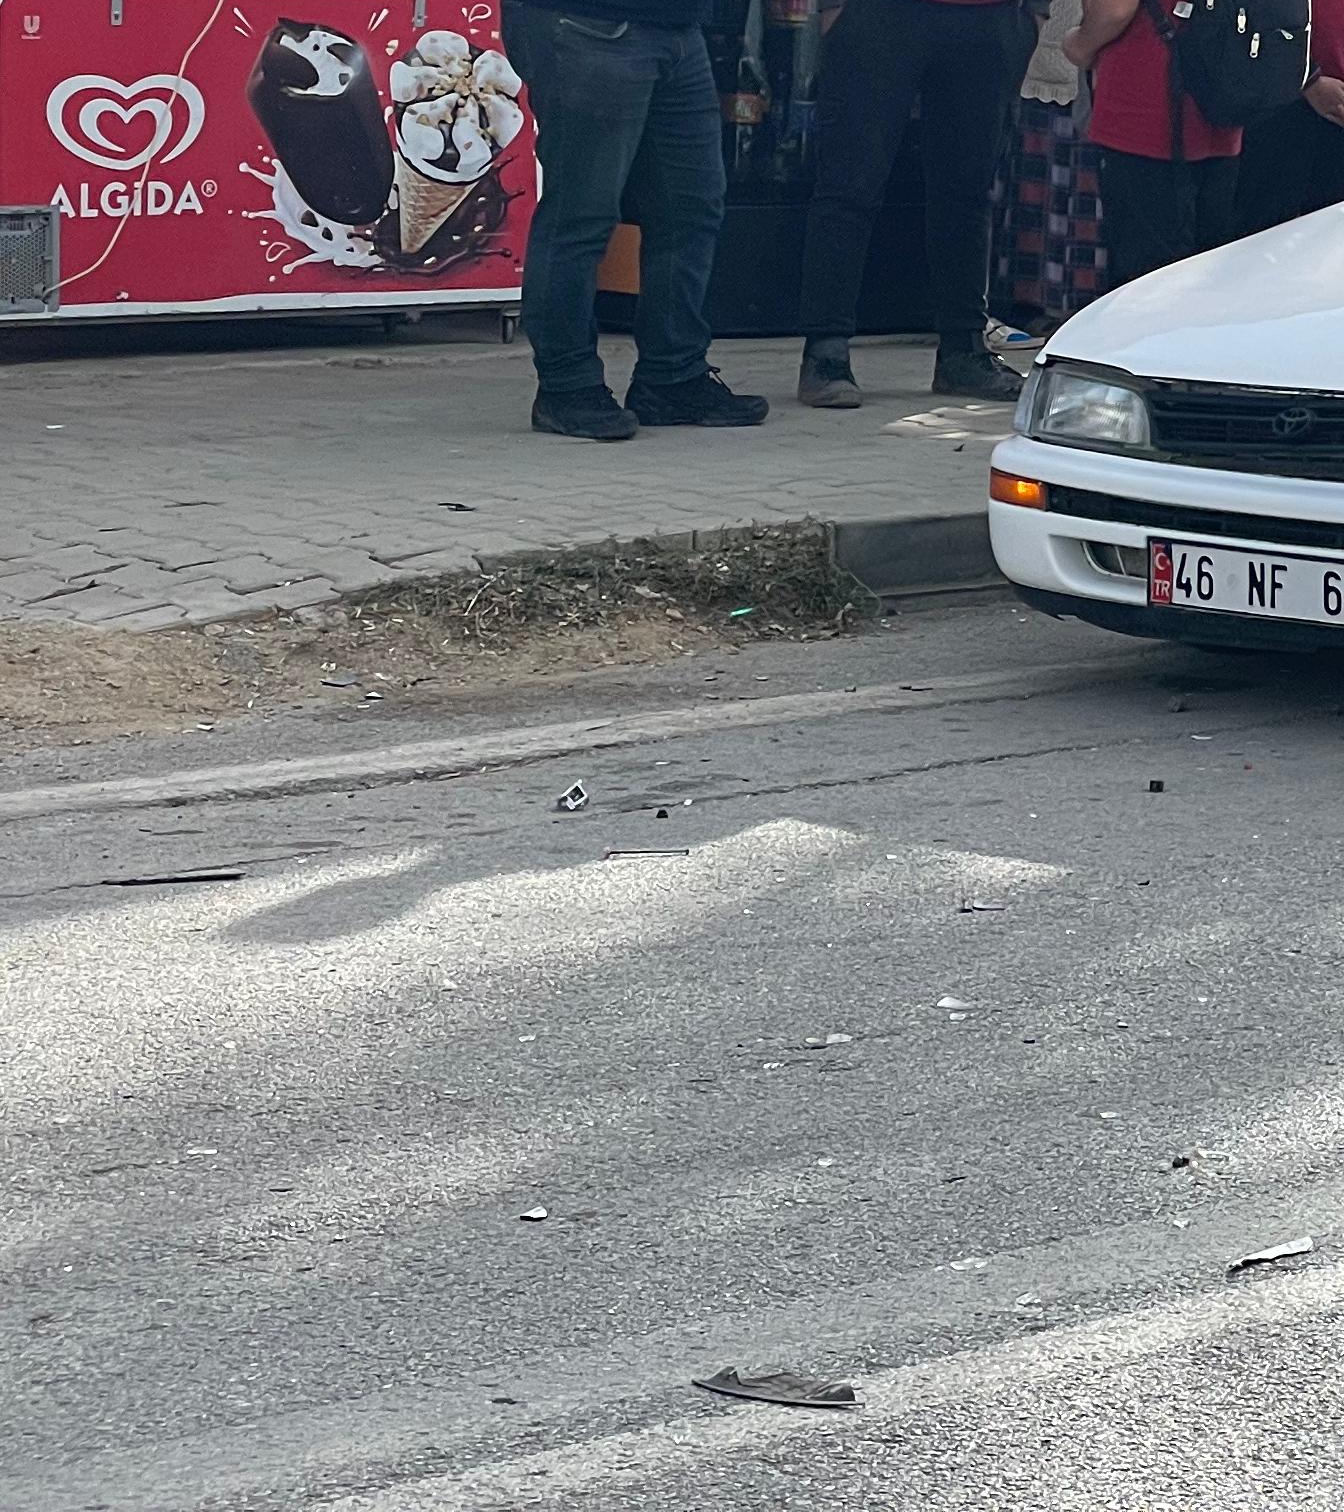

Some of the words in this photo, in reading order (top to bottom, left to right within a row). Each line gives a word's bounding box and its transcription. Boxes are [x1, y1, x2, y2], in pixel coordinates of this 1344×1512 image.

[1153, 579, 1171, 597] TR
[1175, 552, 1215, 601] 46
[1248, 561, 1288, 609] NF
